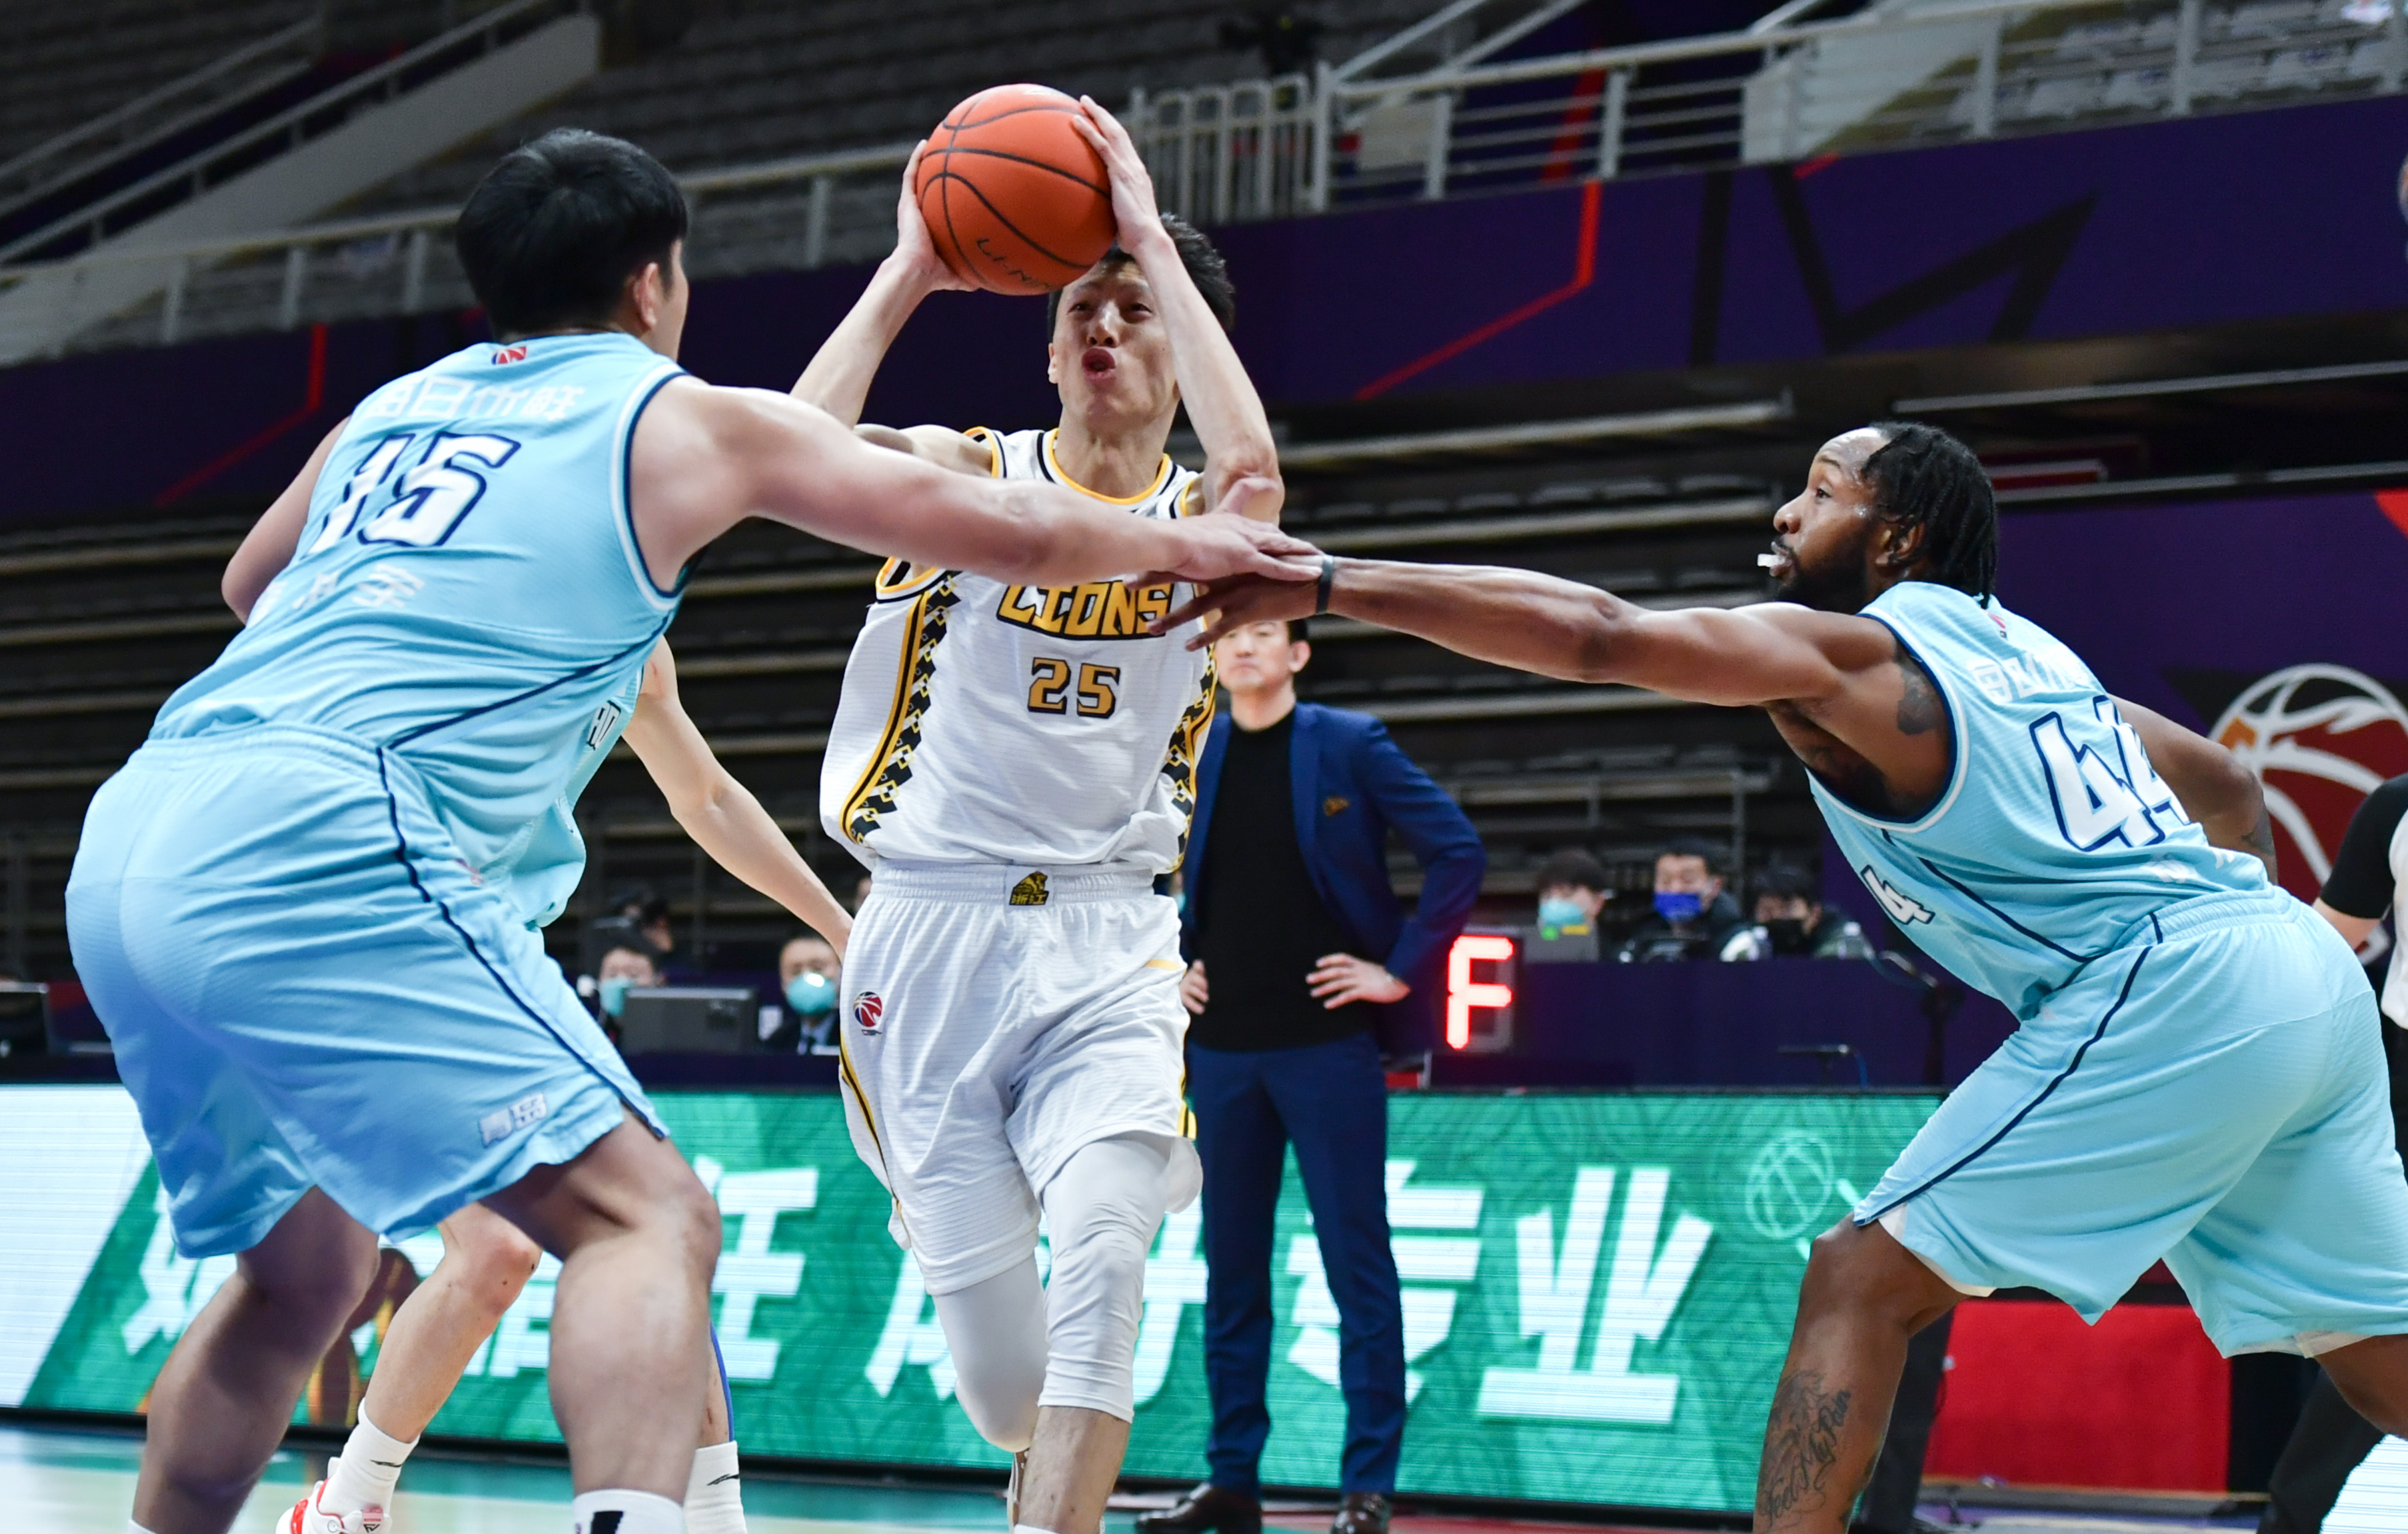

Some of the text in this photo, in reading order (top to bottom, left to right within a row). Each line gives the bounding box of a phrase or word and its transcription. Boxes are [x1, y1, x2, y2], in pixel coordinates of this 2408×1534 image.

[307, 430, 521, 554] 15
[996, 580, 1173, 641] LIONS
[1027, 656, 1120, 719] 25
[2029, 694, 2191, 852] 44
[1446, 934, 1514, 1051] F
